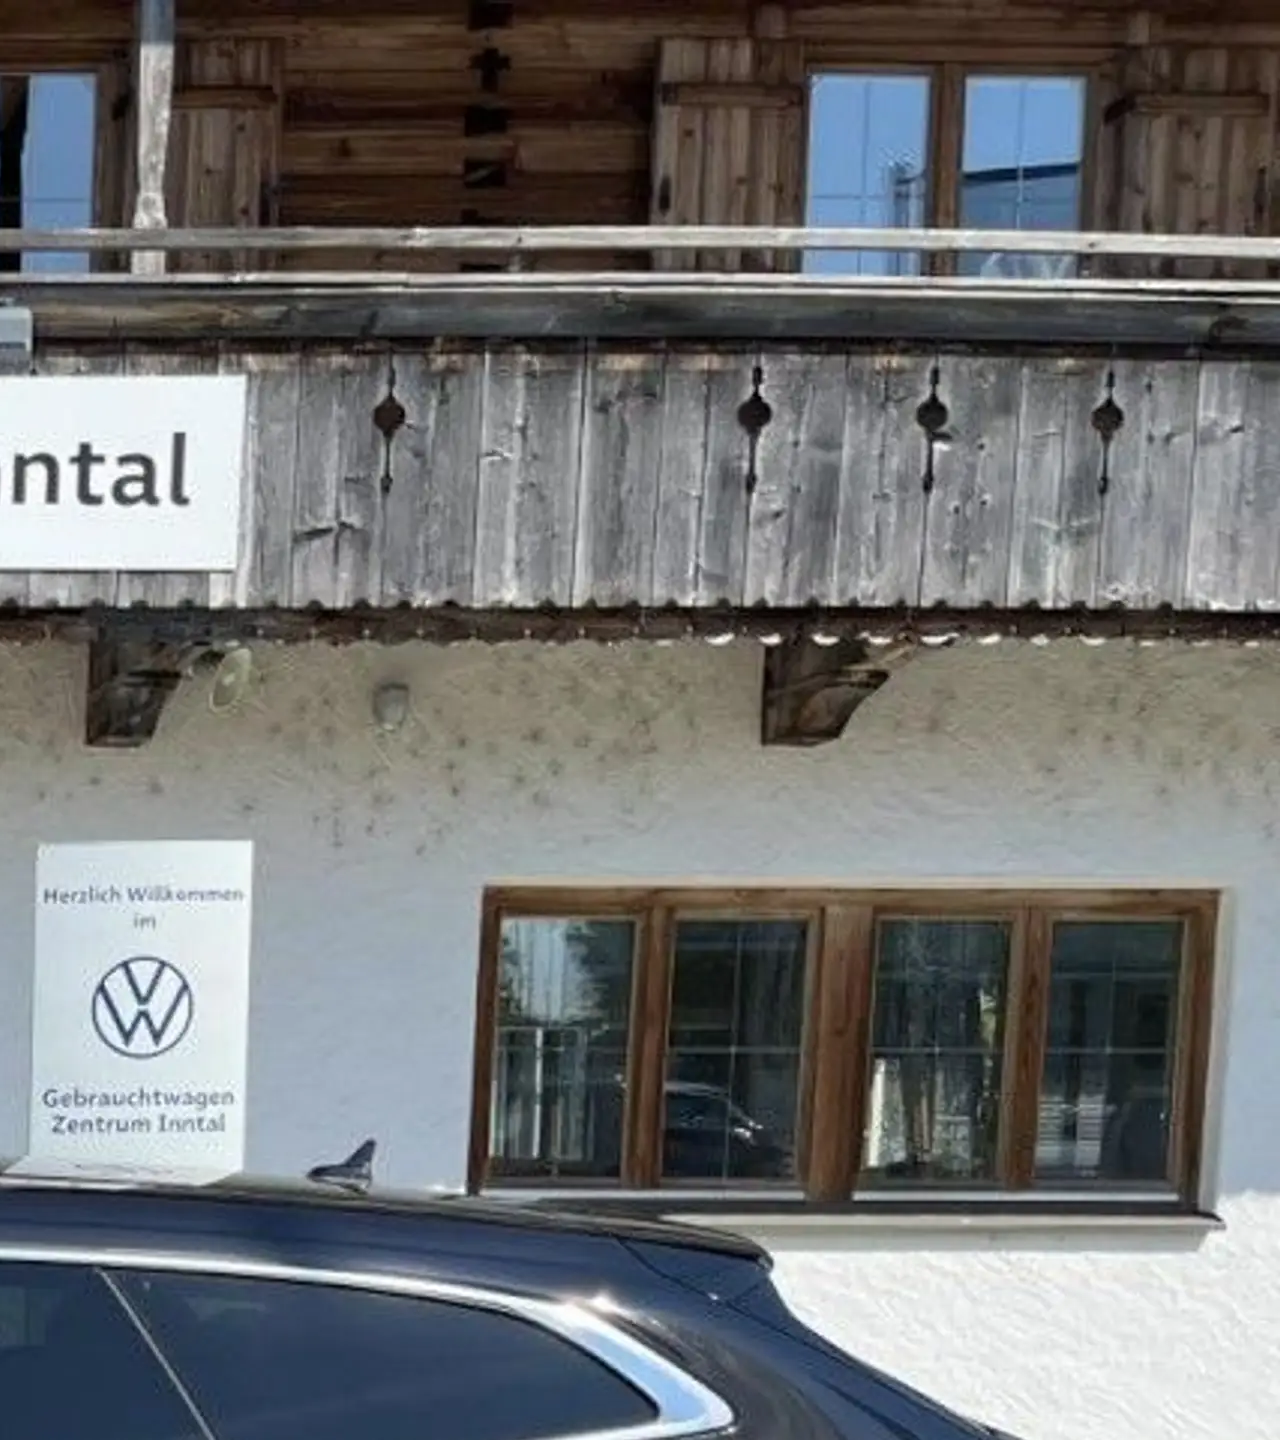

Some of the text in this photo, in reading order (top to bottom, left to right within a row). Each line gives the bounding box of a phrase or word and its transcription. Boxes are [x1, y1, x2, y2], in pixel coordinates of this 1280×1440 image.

[44, 884, 243, 904] Herzlich Willkommen
[134, 913, 156, 930] im
[92, 956, 192, 1059] VW
[41, 1087, 235, 1111] Gebrauchtwagen
[51, 1112, 226, 1134] Zentrum Inntal
